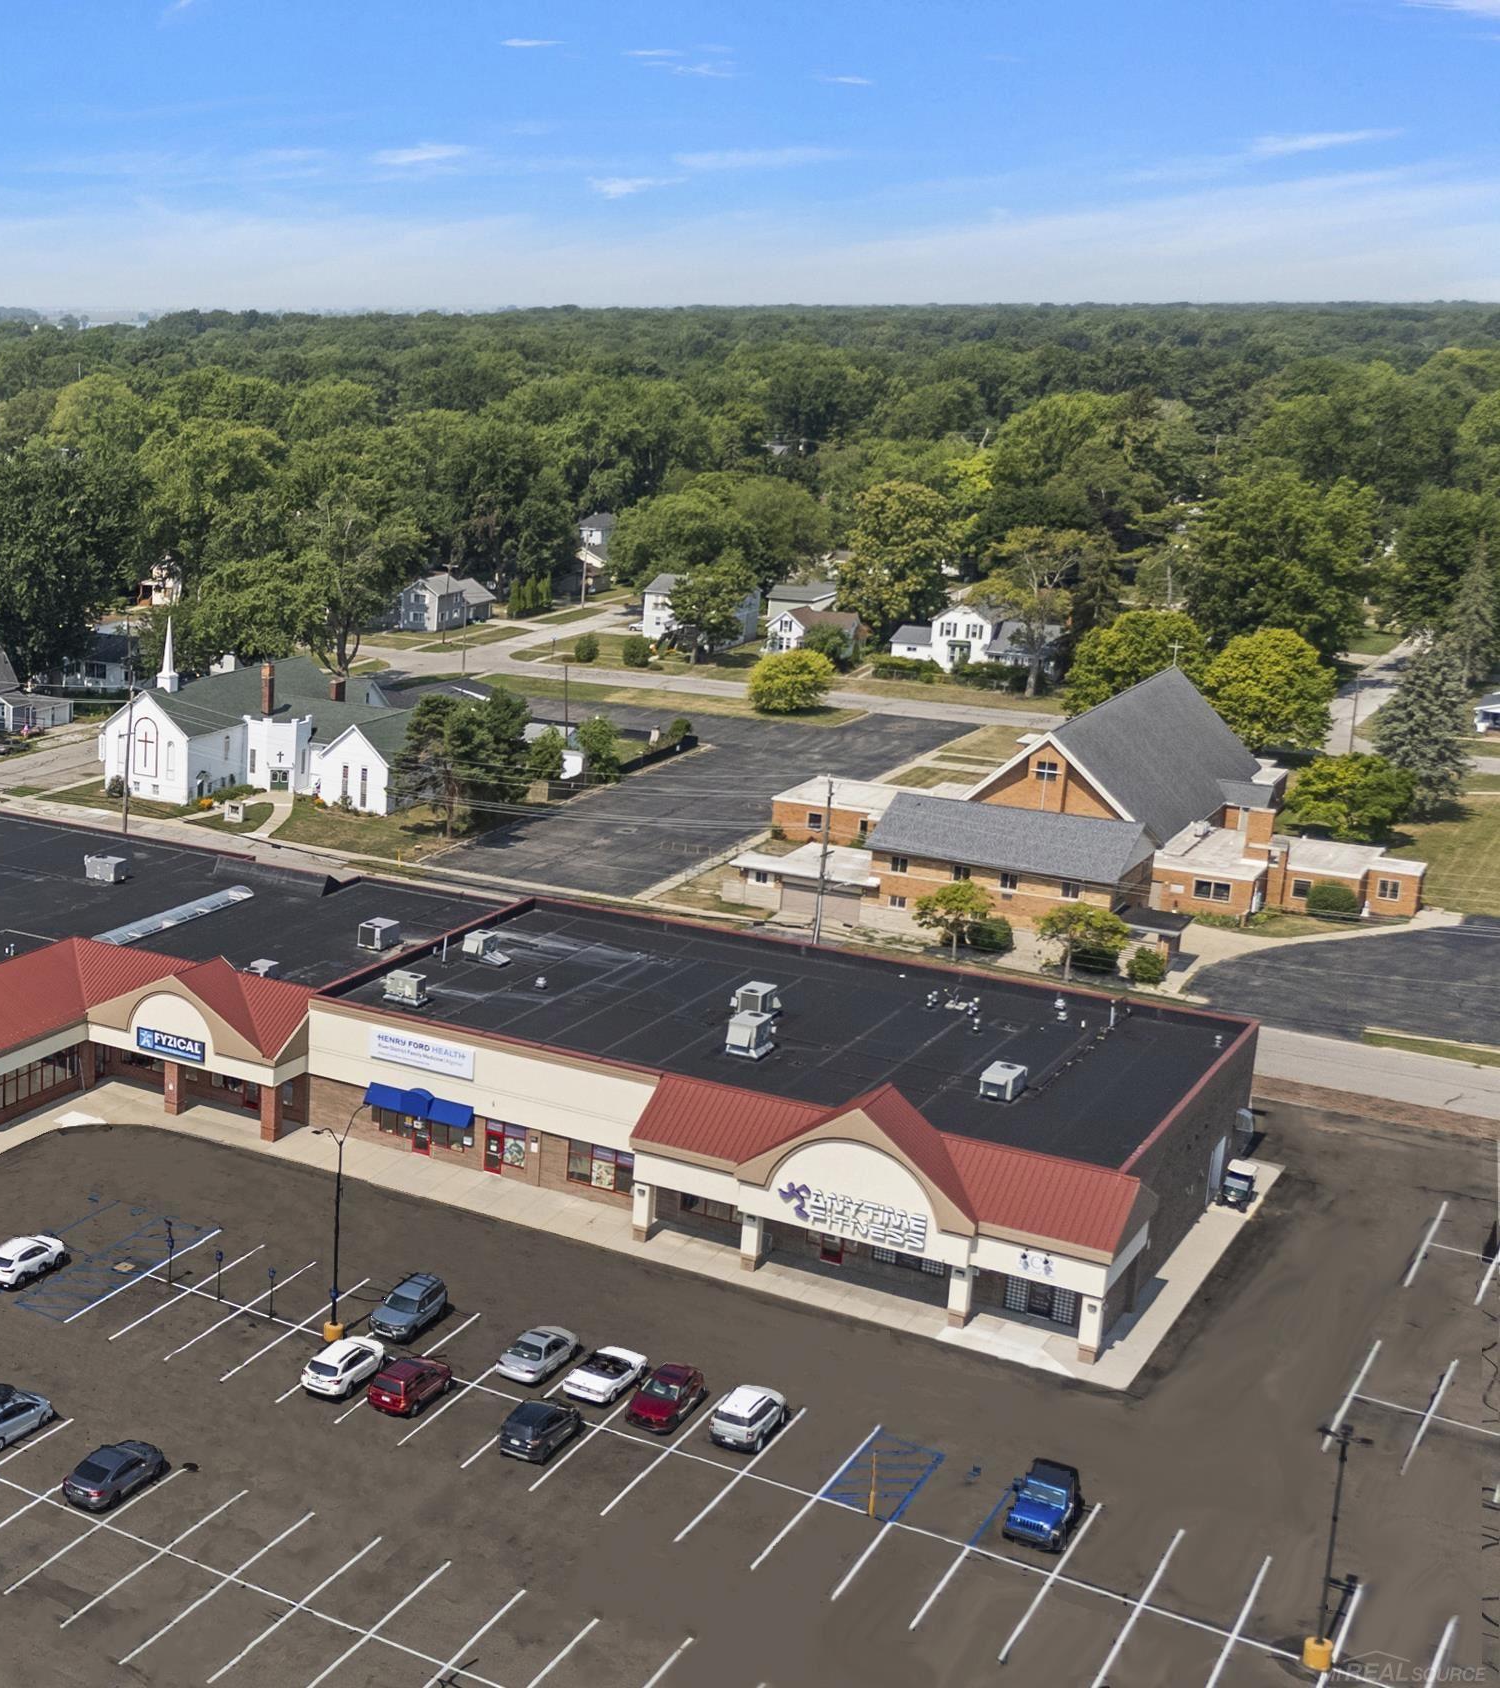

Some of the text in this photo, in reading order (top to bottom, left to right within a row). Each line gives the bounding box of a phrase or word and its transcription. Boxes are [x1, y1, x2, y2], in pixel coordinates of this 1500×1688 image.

[154, 1031, 201, 1054] FYZICAL
[377, 1034, 406, 1047] HENRY
[408, 1040, 430, 1052] FORD
[431, 1046, 466, 1060] HEALTH
[810, 1189, 927, 1234] ANYTIME
[809, 1207, 926, 1252] FITNESS
